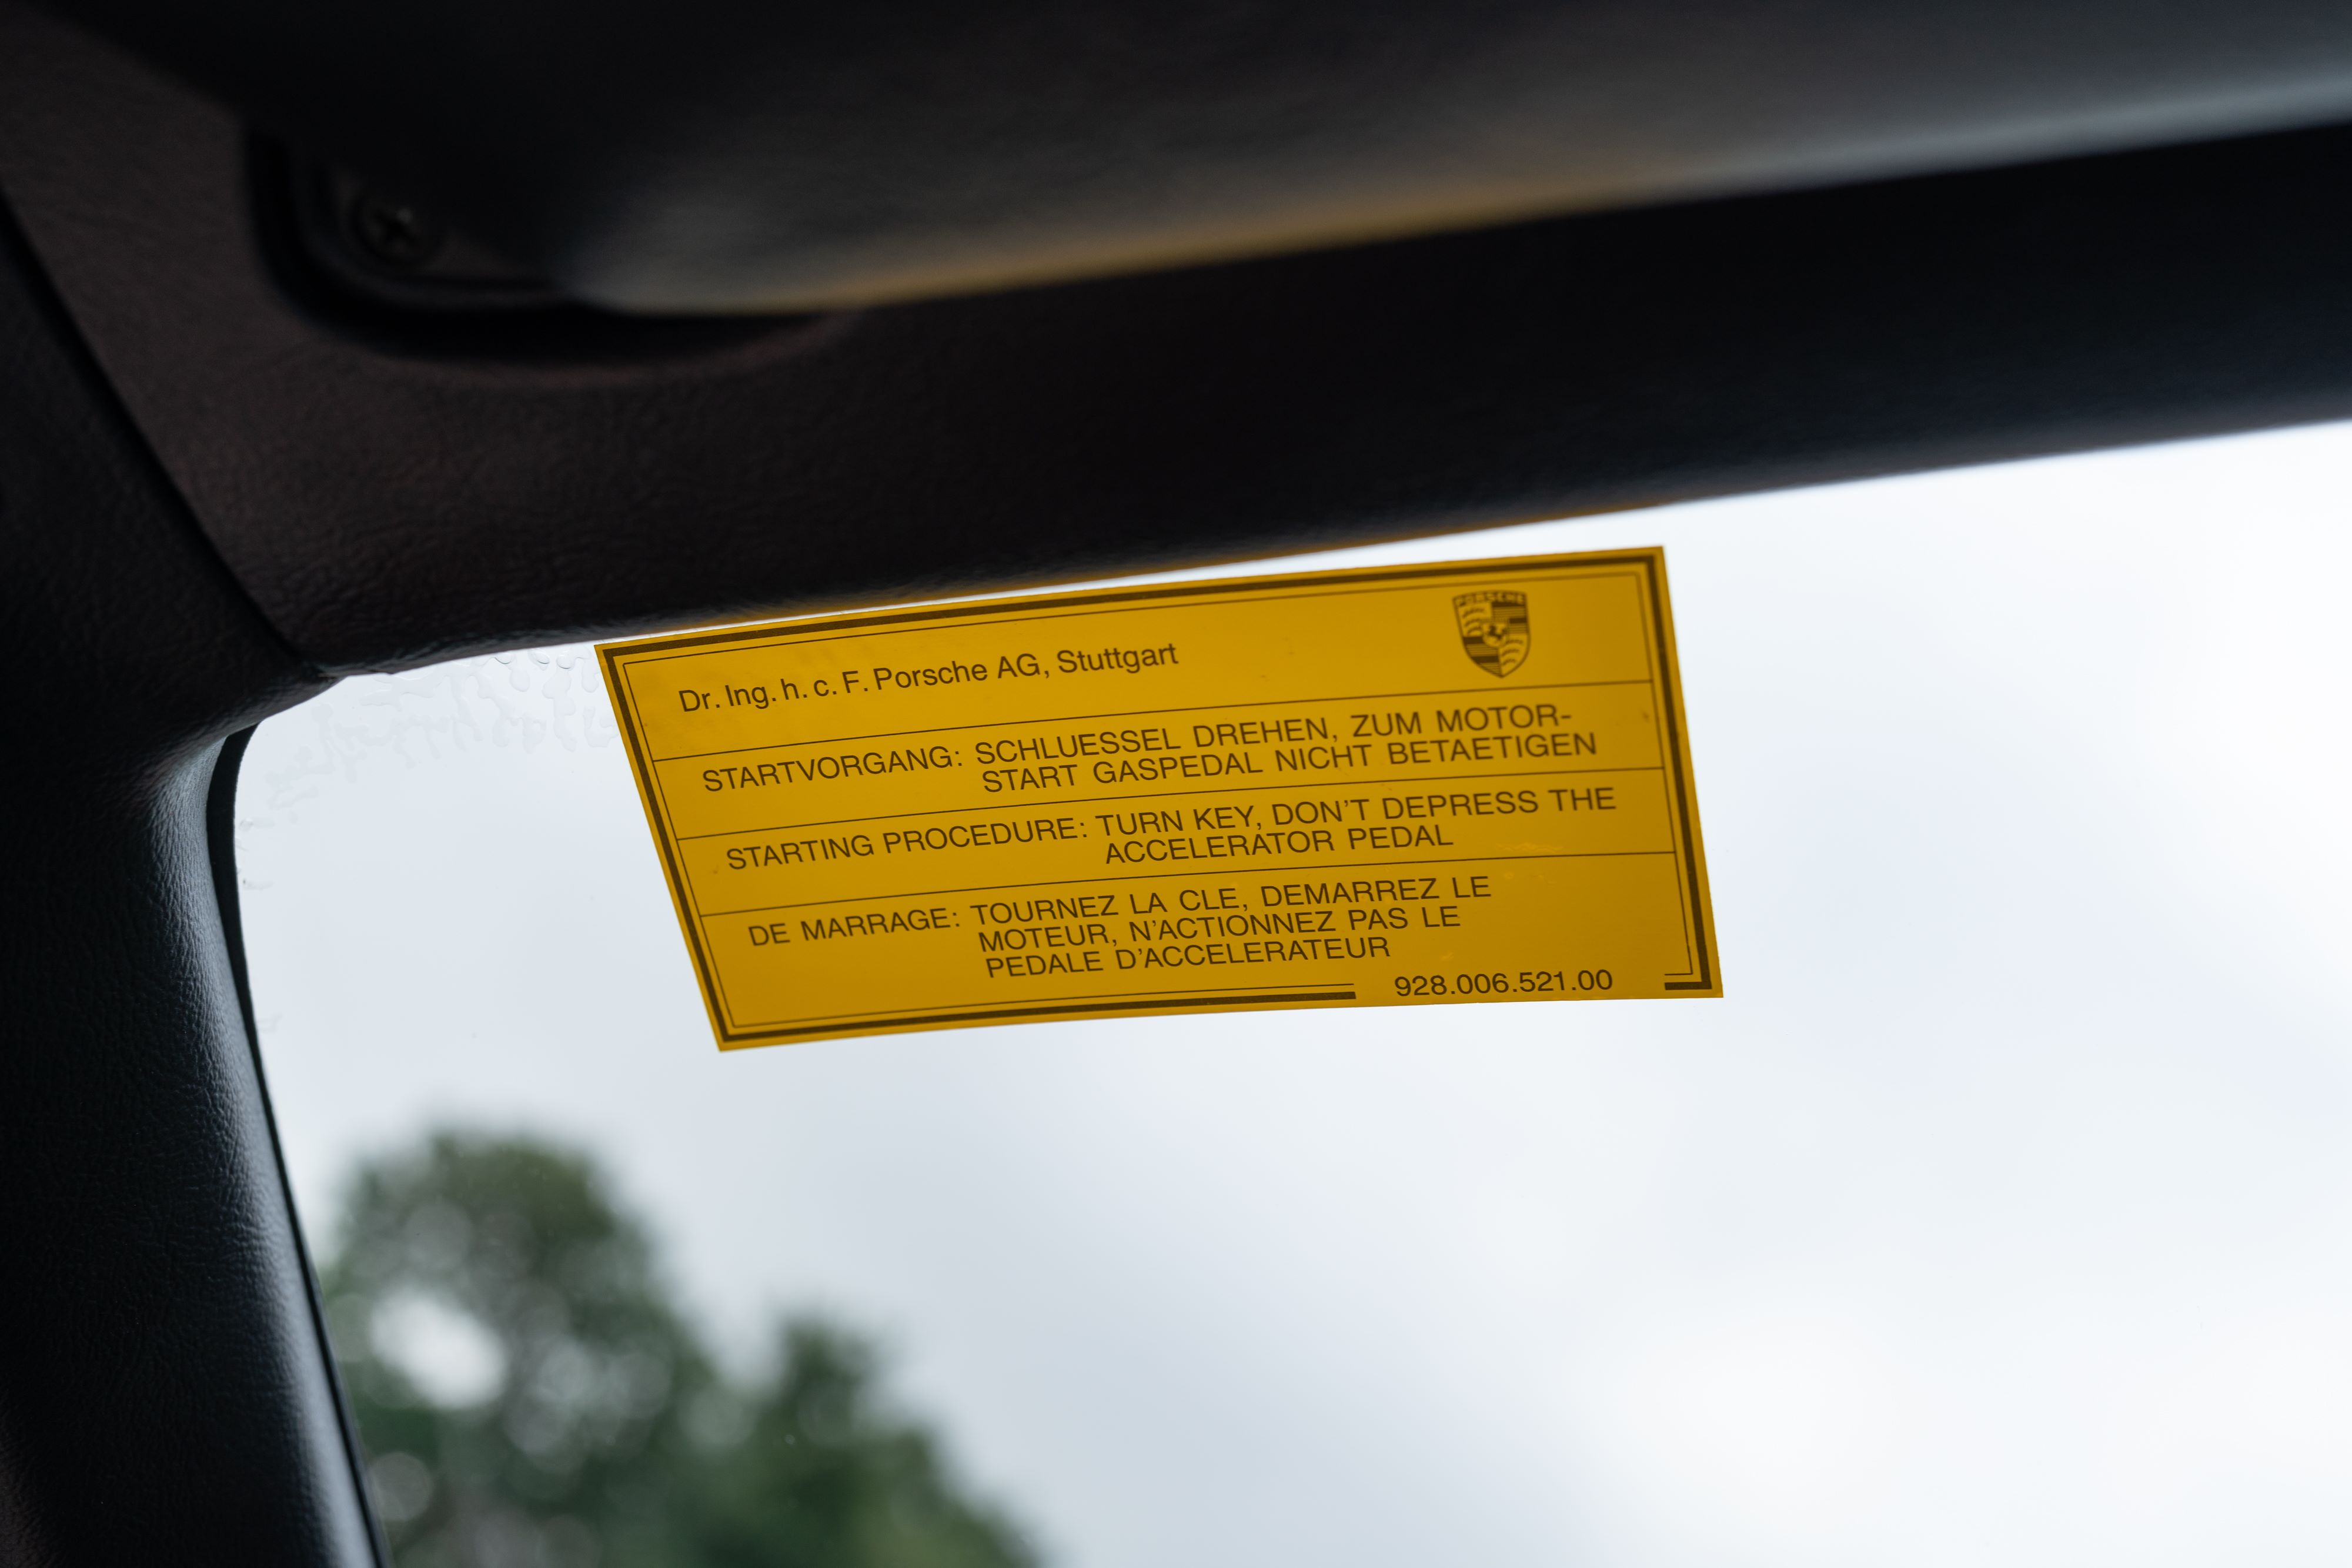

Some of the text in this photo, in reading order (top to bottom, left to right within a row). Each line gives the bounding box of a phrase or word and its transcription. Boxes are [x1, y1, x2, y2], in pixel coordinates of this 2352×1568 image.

[679, 643, 1179, 712] Dr. Ing. h. c. F. Porsche AG, Stuttgart
[703, 704, 1571, 791] STARTVORGANG: SCHLUESSEL DREHEN, ZUM MOTOR-
[983, 733, 1596, 793] START GASPEDAL NICHT BETAETIGEN
[727, 787, 1616, 870] STARTING PROCEDURE: TURN KEY, DON'T DEPRESS THE
[1106, 824, 1454, 864] ACCELERATOR PEDAL
[748, 876, 1491, 946] DE MARRAGE: TOURNEZ LA CLE, DEMARREZ LE
[978, 906, 1461, 952] MOTEUR, N'ACTIONNEZ PAS LE
[985, 937, 1390, 978] PEDALE D'ACCELERATEUR
[1395, 969, 1612, 997] 928.006.521.00
